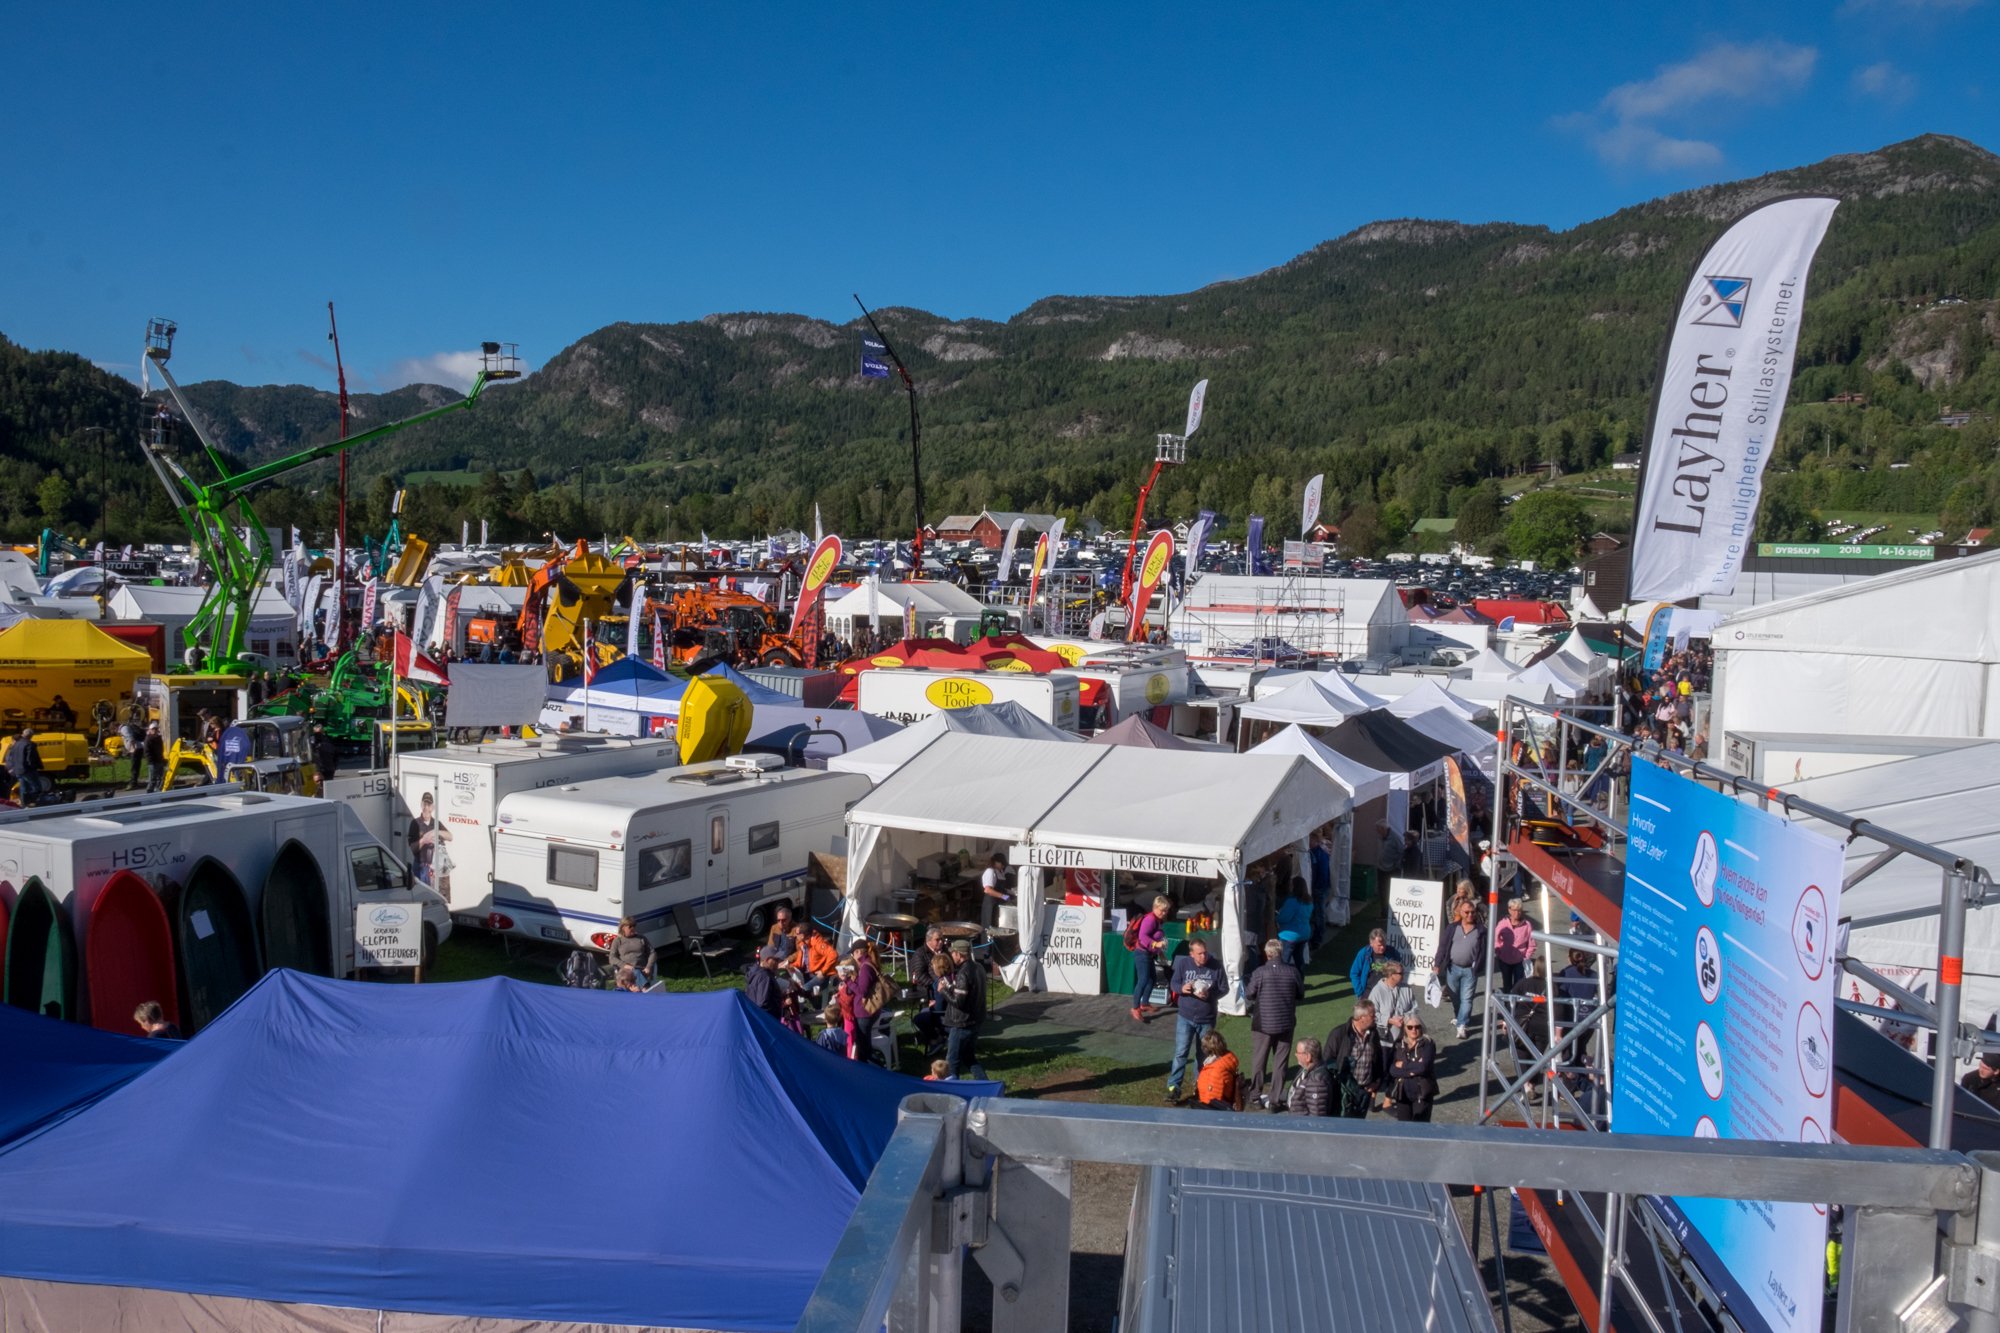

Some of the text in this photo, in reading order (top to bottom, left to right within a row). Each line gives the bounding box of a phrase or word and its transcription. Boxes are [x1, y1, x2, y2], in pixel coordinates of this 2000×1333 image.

[1712, 276, 1798, 583] Flere muligheter. Stillassystemet.
[1654, 354, 1733, 538] Layher
[1839, 546, 1862, 554] 2018
[1878, 546, 1906, 556] 14-16
[1906, 548, 1934, 558] sept.
[1057, 647, 1078, 655] IDG-
[944, 682, 976, 694] IDG-
[943, 695, 976, 708] Tools
[454, 772, 479, 787] HSX
[448, 817, 479, 825] HONDA
[1632, 812, 1656, 834] Hvorfor
[1630, 834, 1647, 853] velge
[87, 842, 186, 878] www. HSX .NO
[1029, 848, 1084, 866] ELGPITA
[1120, 854, 1199, 875] HJORTEBURGER
[1720, 861, 1767, 903] Hvem andre kan
[1390, 912, 1434, 931] ELGPITA
[362, 936, 398, 946] ELGPITA
[1042, 935, 1082, 949] ELGPITA
[362, 948, 418, 963] HJORTEBURGER
[1042, 952, 1100, 968] HJORTEBURGER
